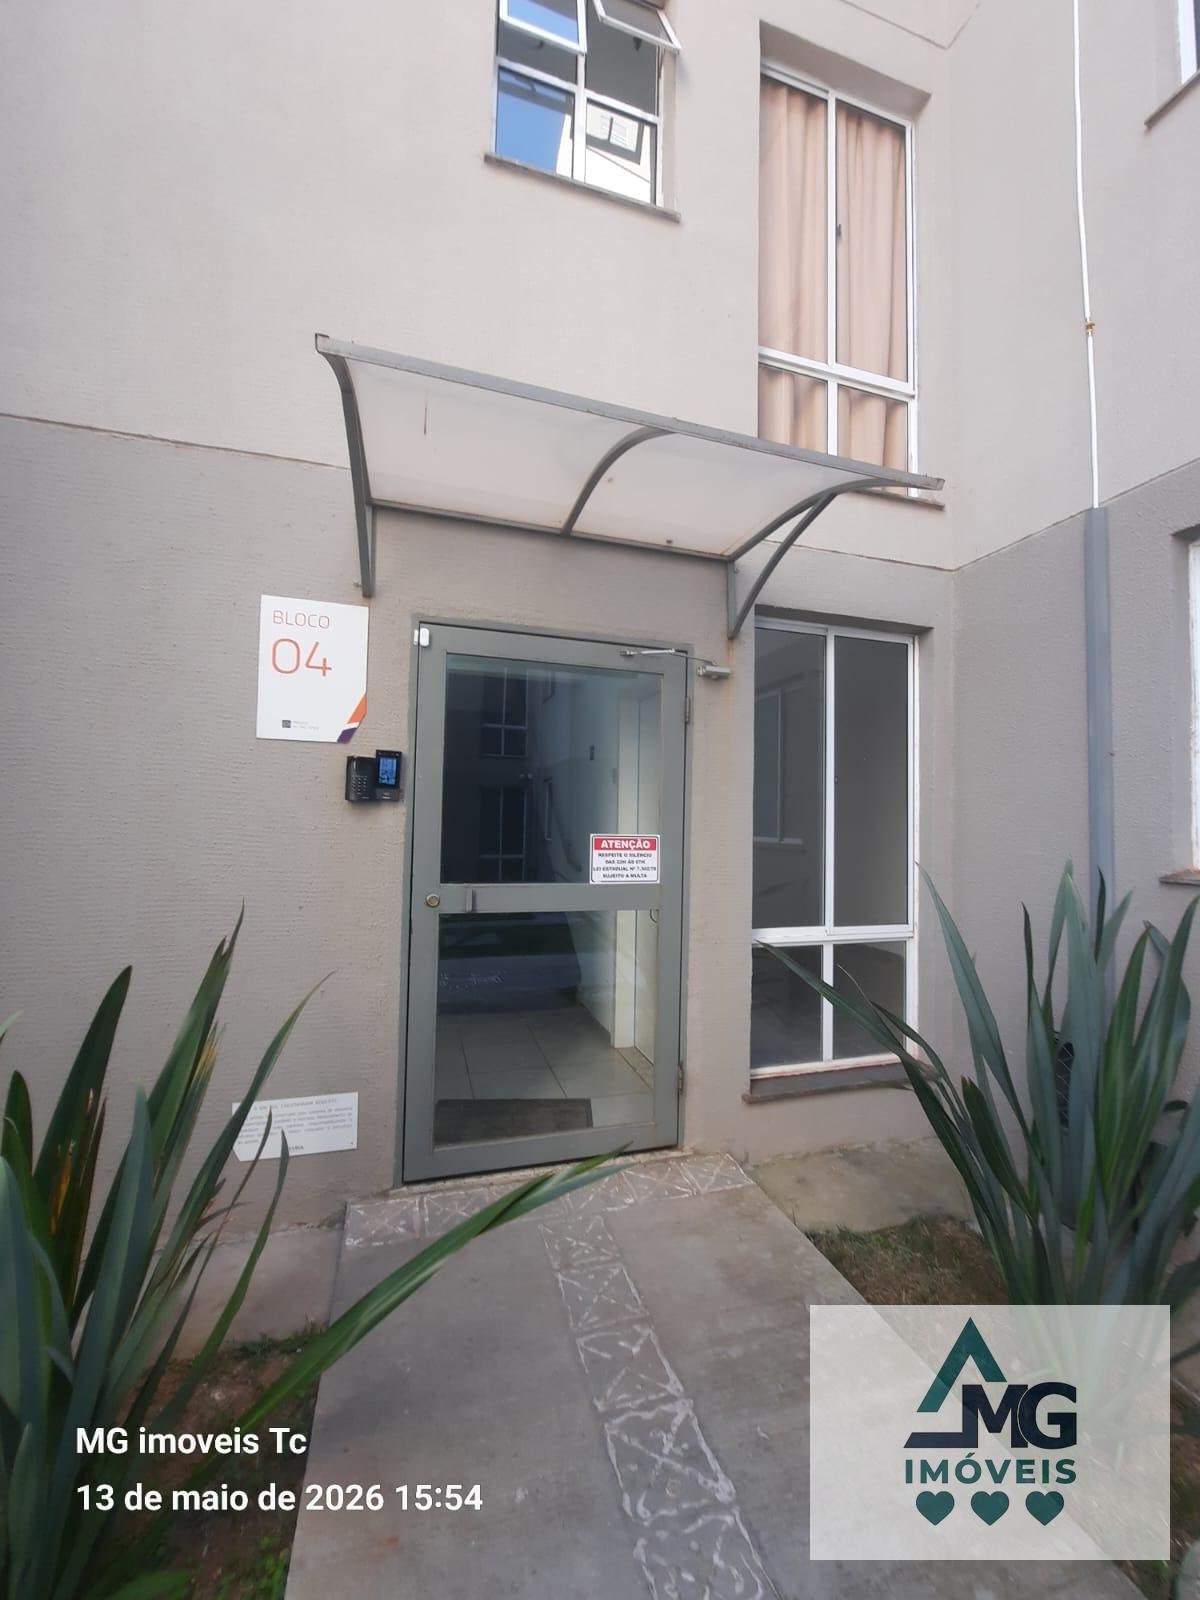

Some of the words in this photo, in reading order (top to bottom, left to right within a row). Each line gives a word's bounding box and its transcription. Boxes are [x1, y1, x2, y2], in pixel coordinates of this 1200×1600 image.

[272, 609, 330, 629] BLOCO
[271, 637, 332, 677] 04
[601, 838, 651, 850] ATENÇÃO
